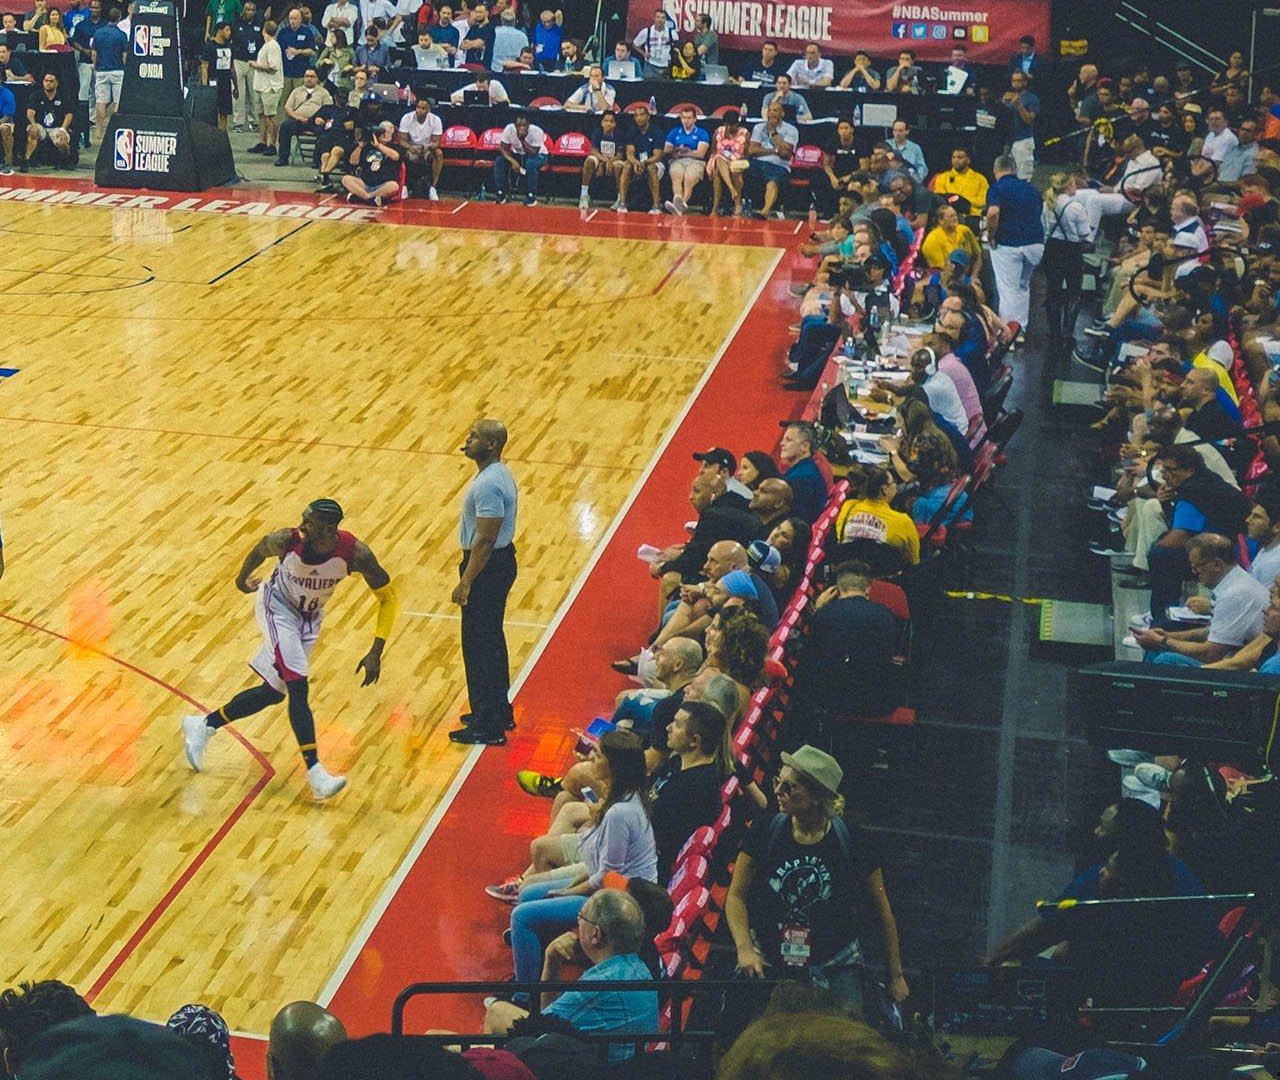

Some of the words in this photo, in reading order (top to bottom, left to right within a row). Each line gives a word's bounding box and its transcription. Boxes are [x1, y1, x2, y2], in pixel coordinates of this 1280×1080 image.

[766, 4, 833, 41] LEAGUE
[893, 5, 989, 24] #NBASummer
[139, 63, 163, 80] @NBA
[136, 135, 177, 155] SUMMER
[135, 152, 169, 172] LEAGUE
[169, 196, 383, 224] LEAGUE
